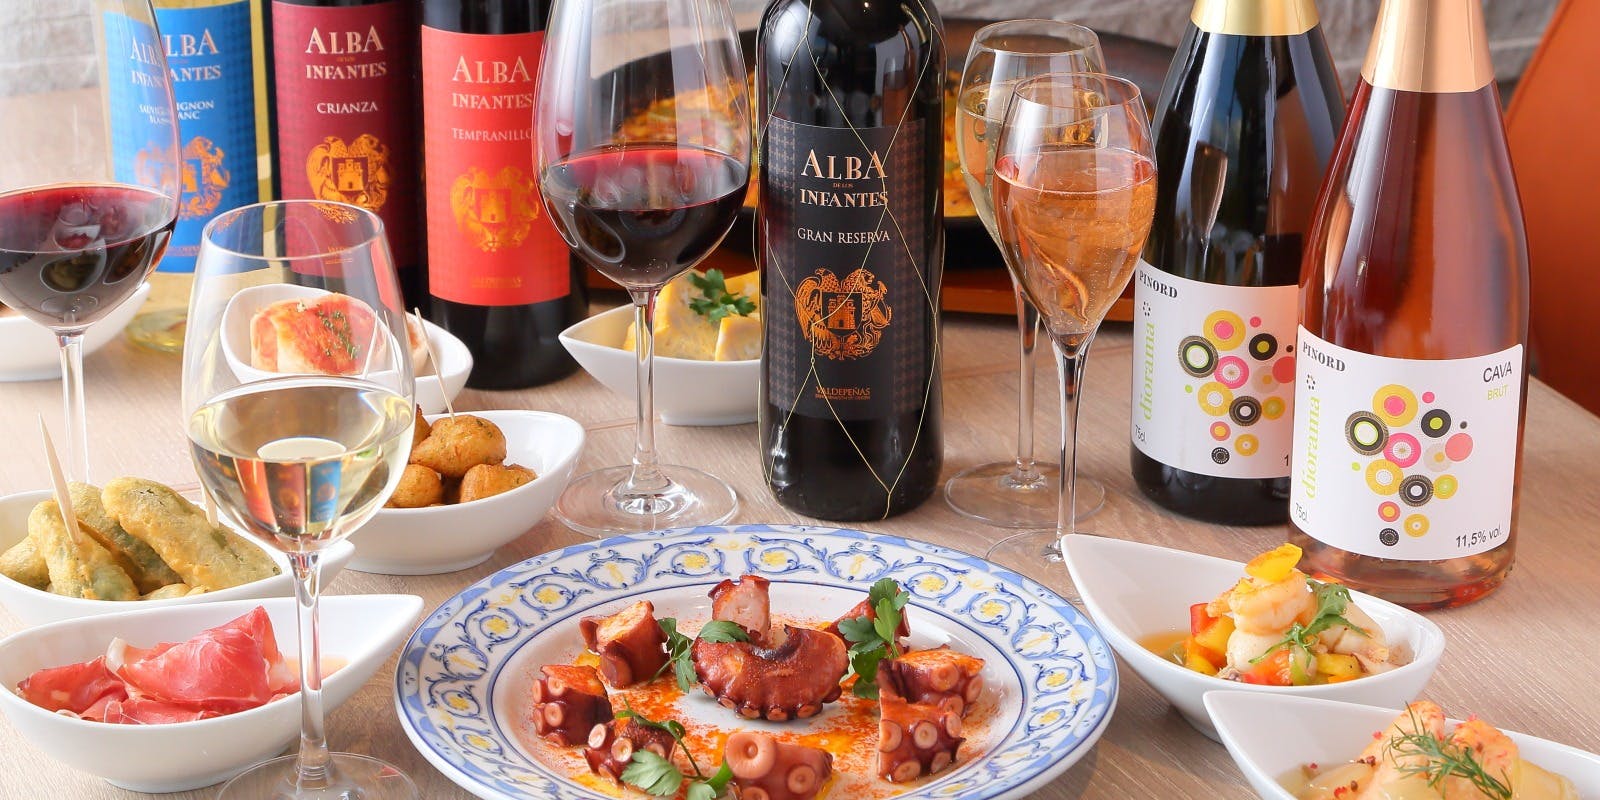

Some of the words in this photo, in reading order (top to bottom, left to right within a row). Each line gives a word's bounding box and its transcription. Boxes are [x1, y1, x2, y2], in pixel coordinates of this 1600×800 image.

[305, 25, 384, 54] ALBA
[305, 61, 387, 80] INFANTES
[452, 55, 531, 84] ALBA
[316, 101, 378, 114] CRIANZA
[452, 92, 533, 109] INFANTES
[801, 149, 888, 180] ALBA
[800, 188, 888, 208] INFANTES
[797, 227, 833, 243] GRAN
[838, 231, 891, 244] RESERVA
[1139, 270, 1178, 298] PINORD
[1302, 341, 1346, 372] PINORD
[1139, 322, 1155, 421] diorama
[1483, 361, 1513, 383] CAVA
[1487, 384, 1509, 400] BRUT
[1302, 396, 1321, 499] diorama
[1455, 529, 1487, 549] 11,5%
